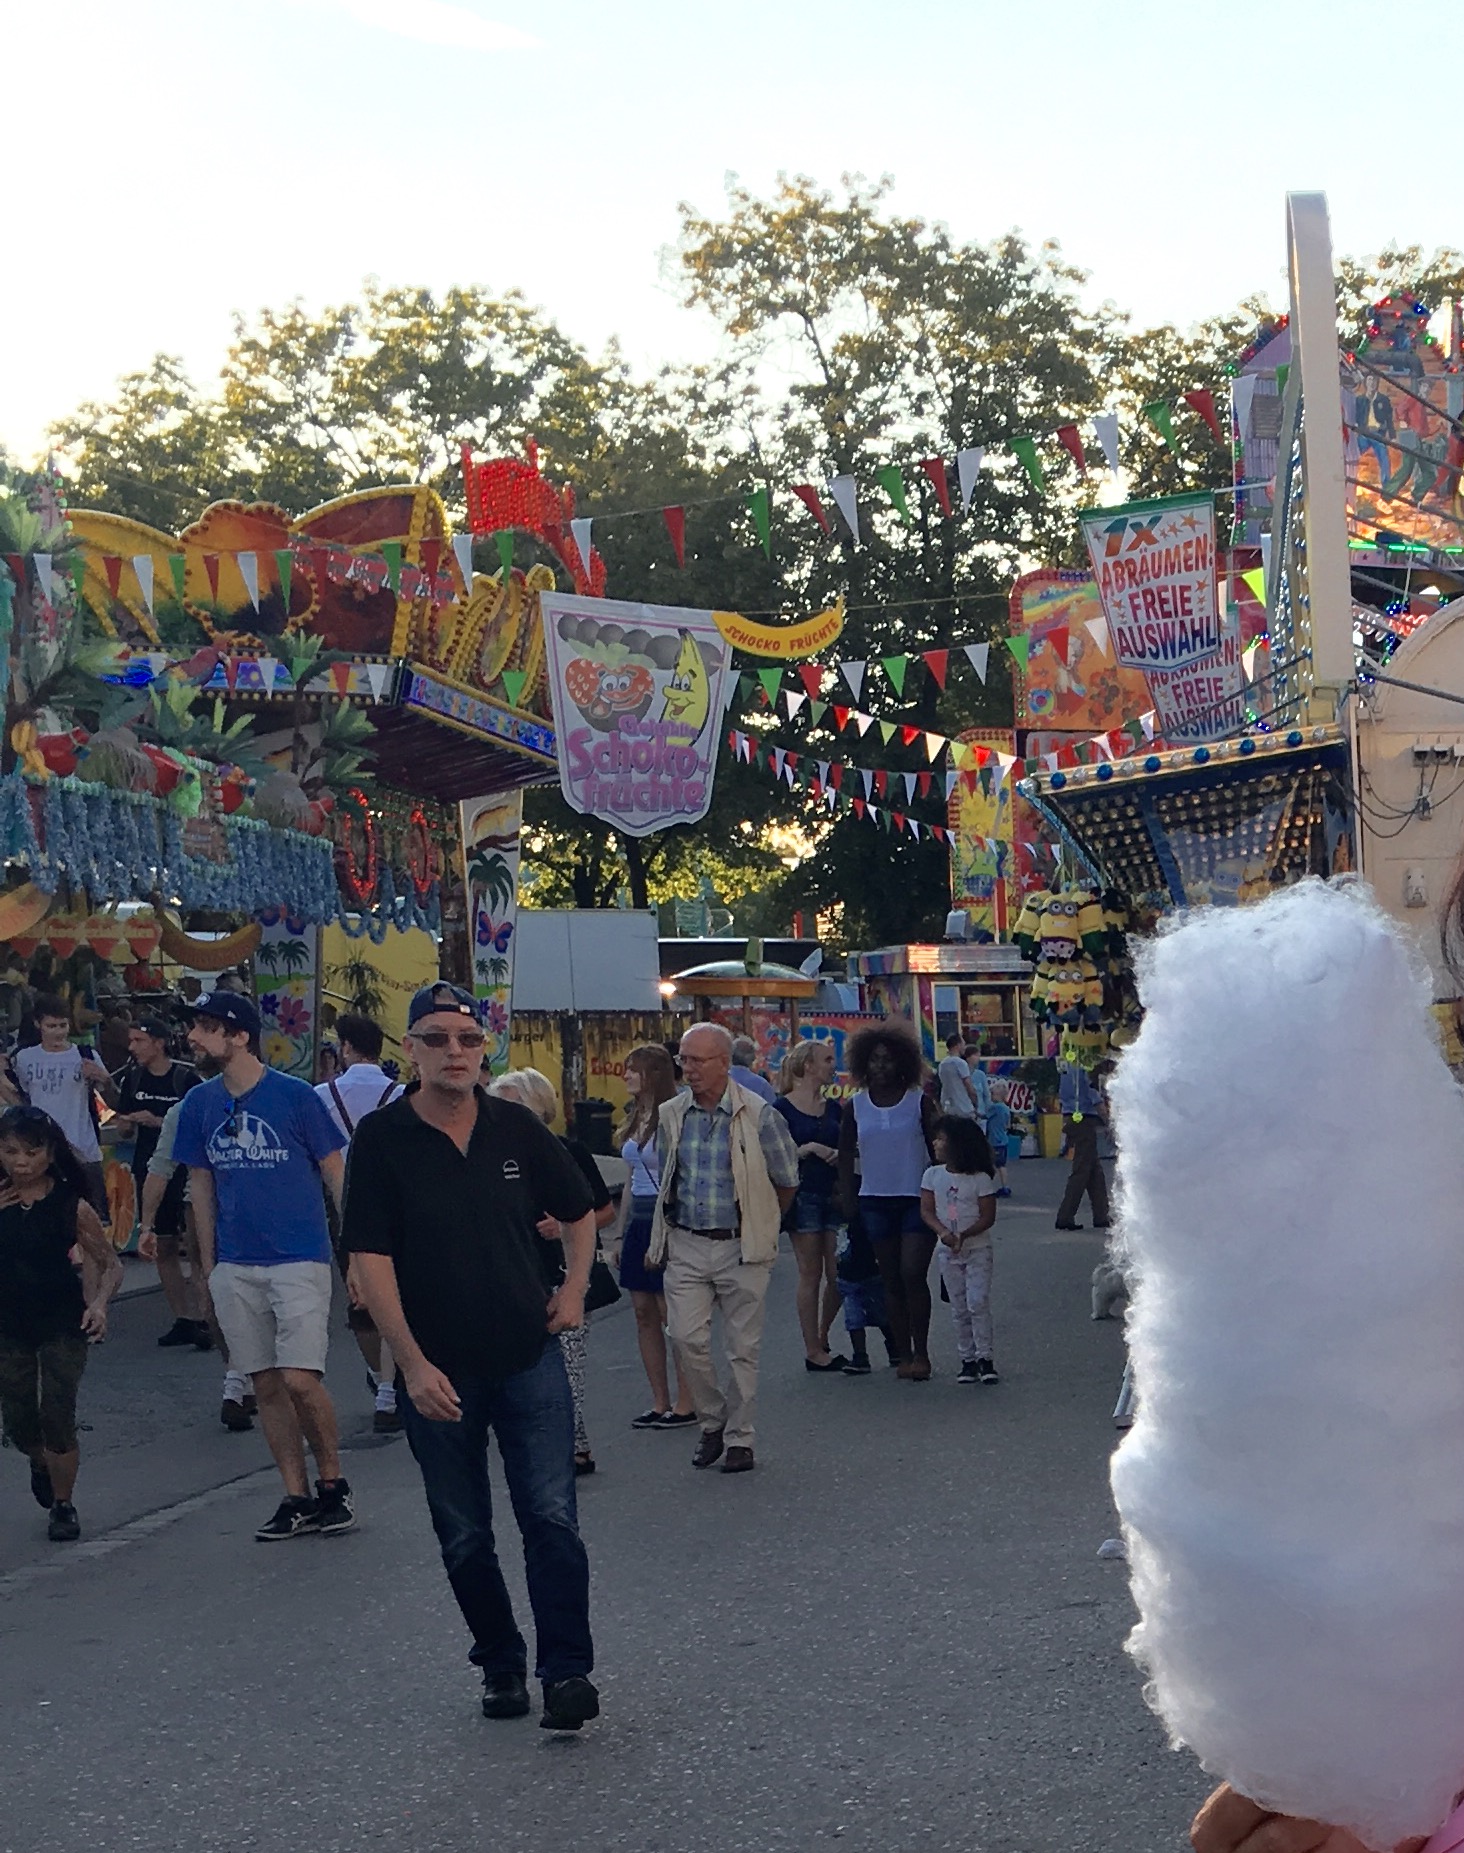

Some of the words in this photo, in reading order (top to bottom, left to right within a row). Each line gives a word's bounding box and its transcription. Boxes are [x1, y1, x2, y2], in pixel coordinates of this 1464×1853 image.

[1128, 584, 1194, 623] FREIE
[724, 624, 781, 652] SCHOCKO
[789, 617, 841, 652] FRÜCHTE
[1115, 616, 1219, 661] AUSWAHL
[1171, 676, 1225, 709] FREIE
[246, 1145, 289, 1163] WHITE
